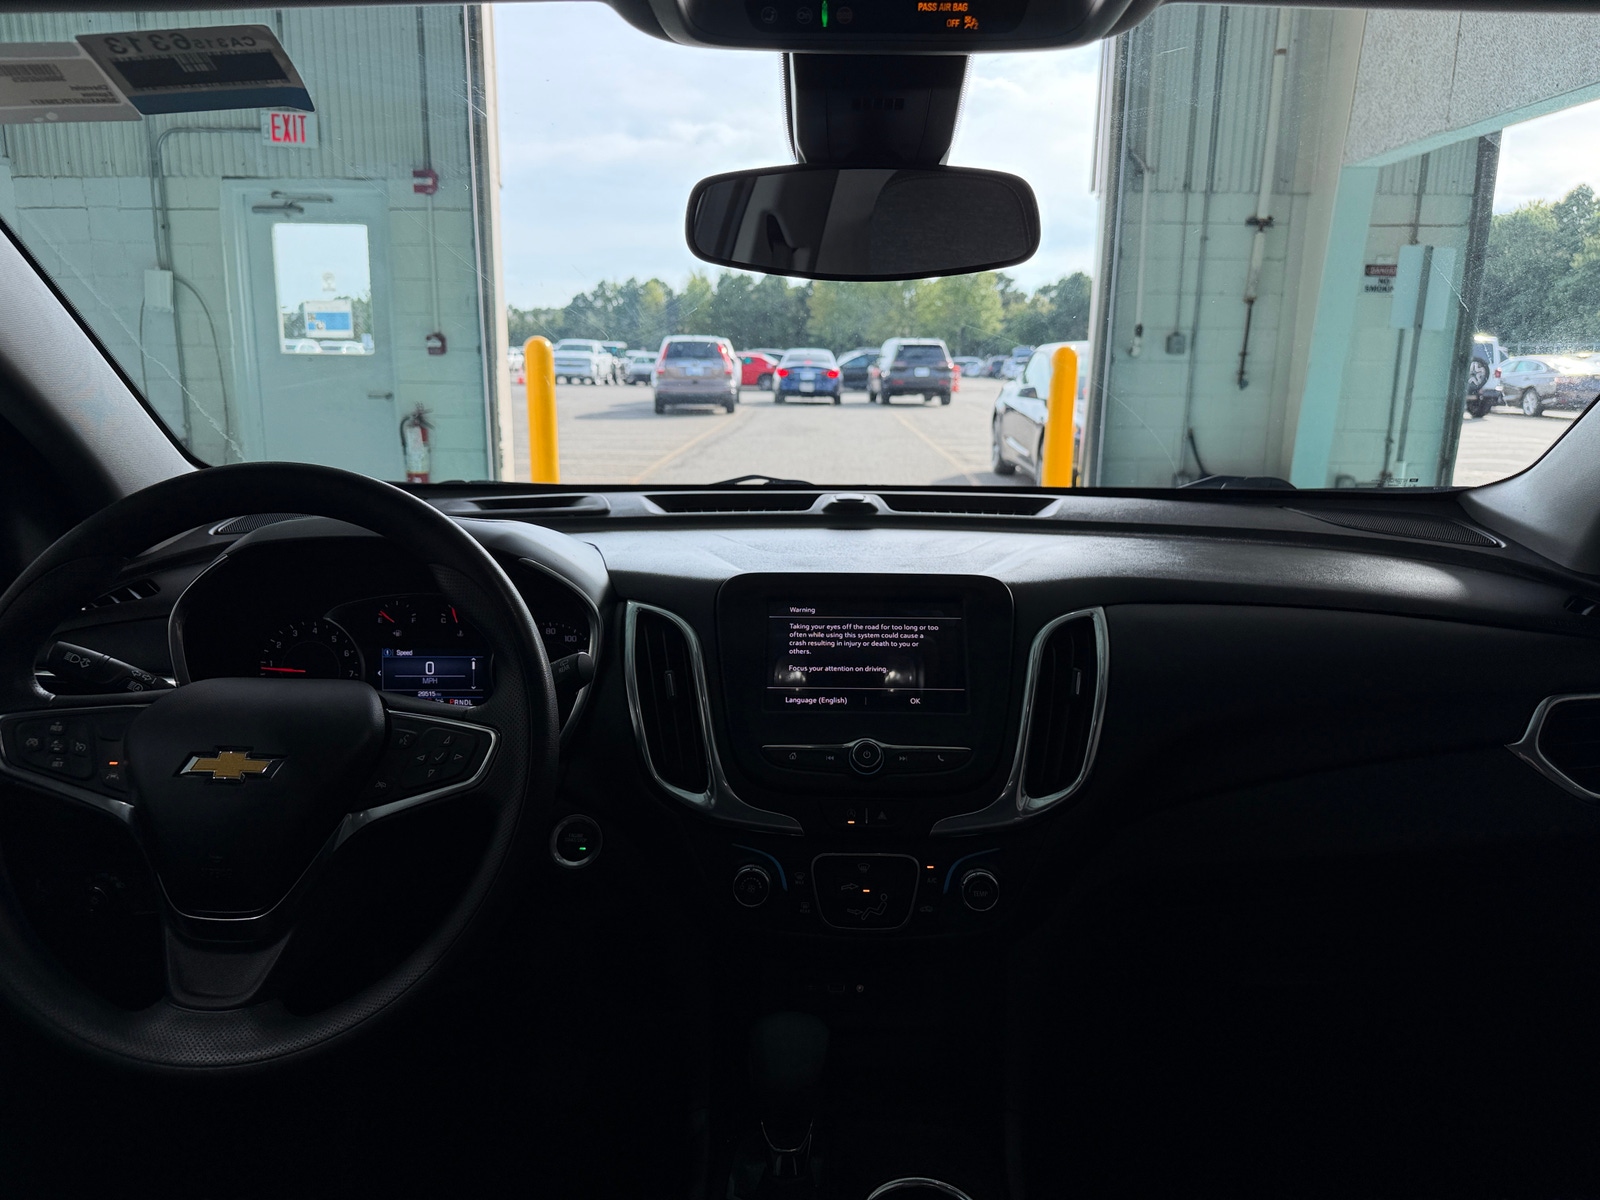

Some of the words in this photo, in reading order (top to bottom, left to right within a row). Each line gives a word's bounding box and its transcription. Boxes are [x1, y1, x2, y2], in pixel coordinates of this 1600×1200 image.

[918, 2, 937, 11] PASS
[938, 2, 952, 11] AIR
[952, 2, 968, 12] BAG
[946, 19, 960, 27] OFF
[271, 113, 307, 143] EXIT
[789, 606, 816, 614] Warning
[292, 629, 298, 637] 3
[425, 661, 435, 675] 0
[785, 697, 817, 705] Language
[818, 697, 847, 705] (English)
